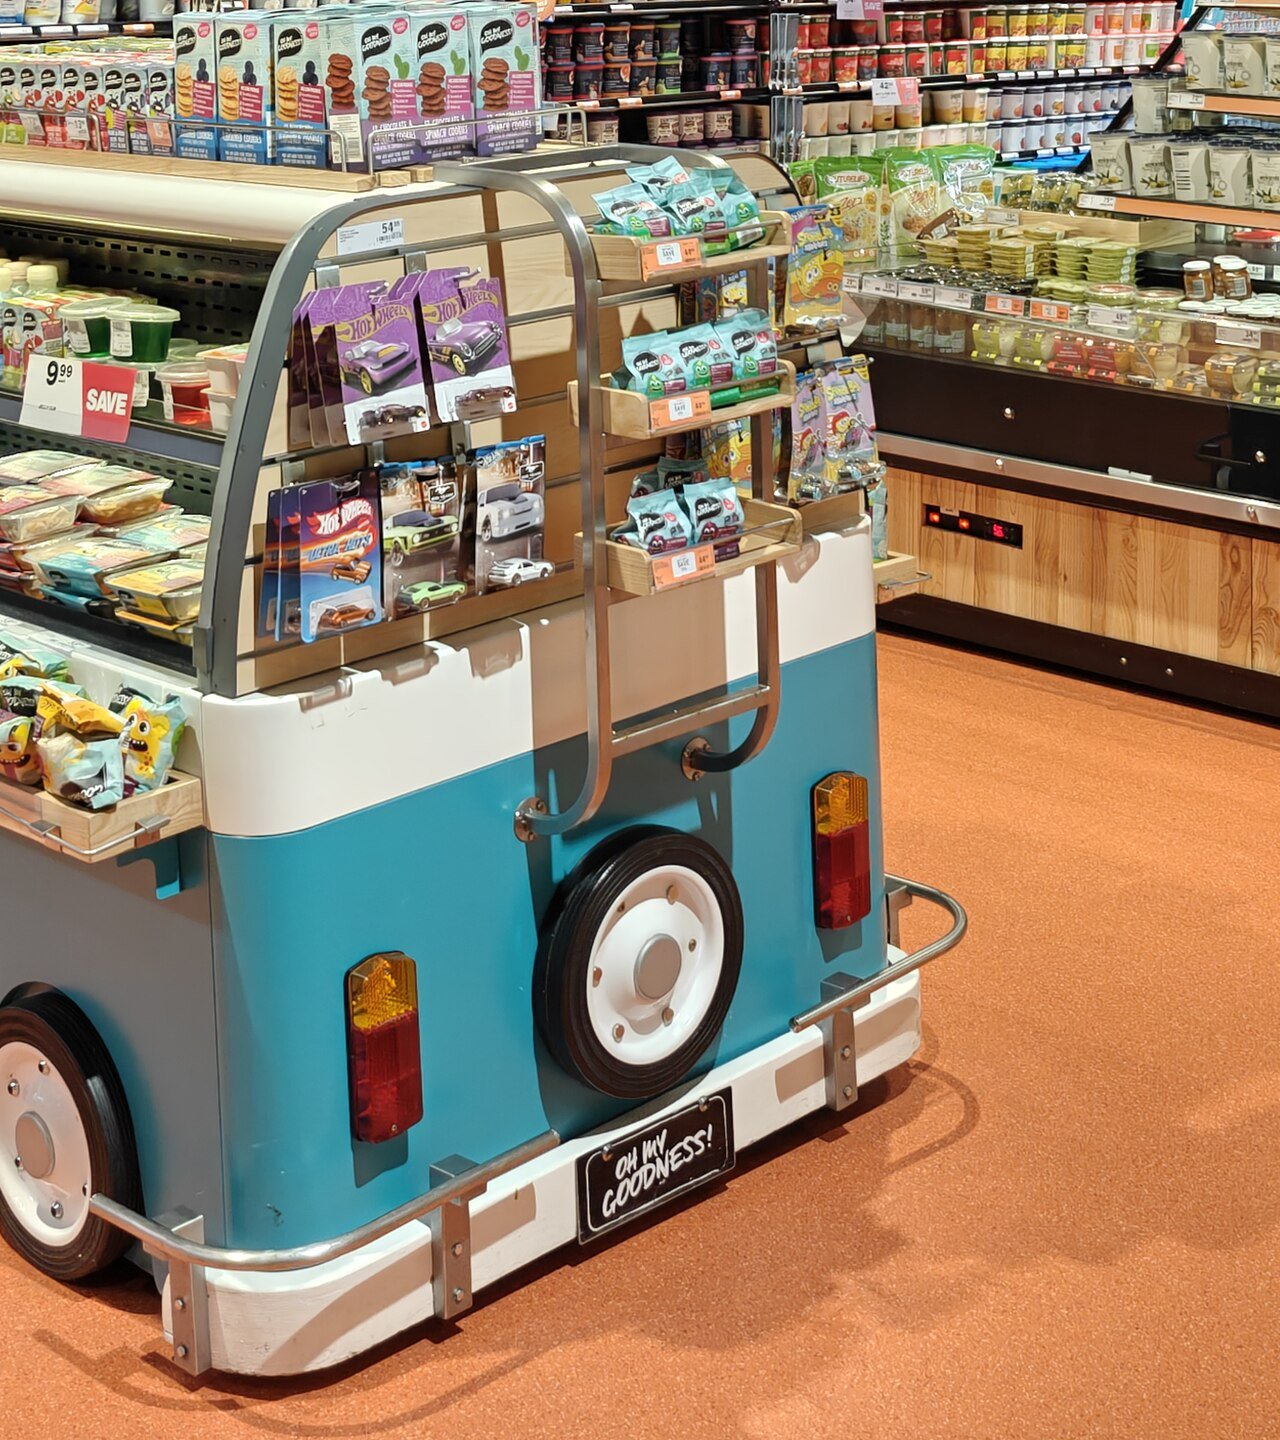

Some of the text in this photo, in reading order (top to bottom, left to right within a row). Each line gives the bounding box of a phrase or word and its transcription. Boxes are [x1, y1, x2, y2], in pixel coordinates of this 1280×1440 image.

[351, 306, 409, 339] HOT WHEELS
[86, 388, 128, 416] SAVE
[316, 507, 339, 535] HOT
[602, 1124, 713, 1218] GOODNESS!
[615, 1129, 667, 1180] OH MY
